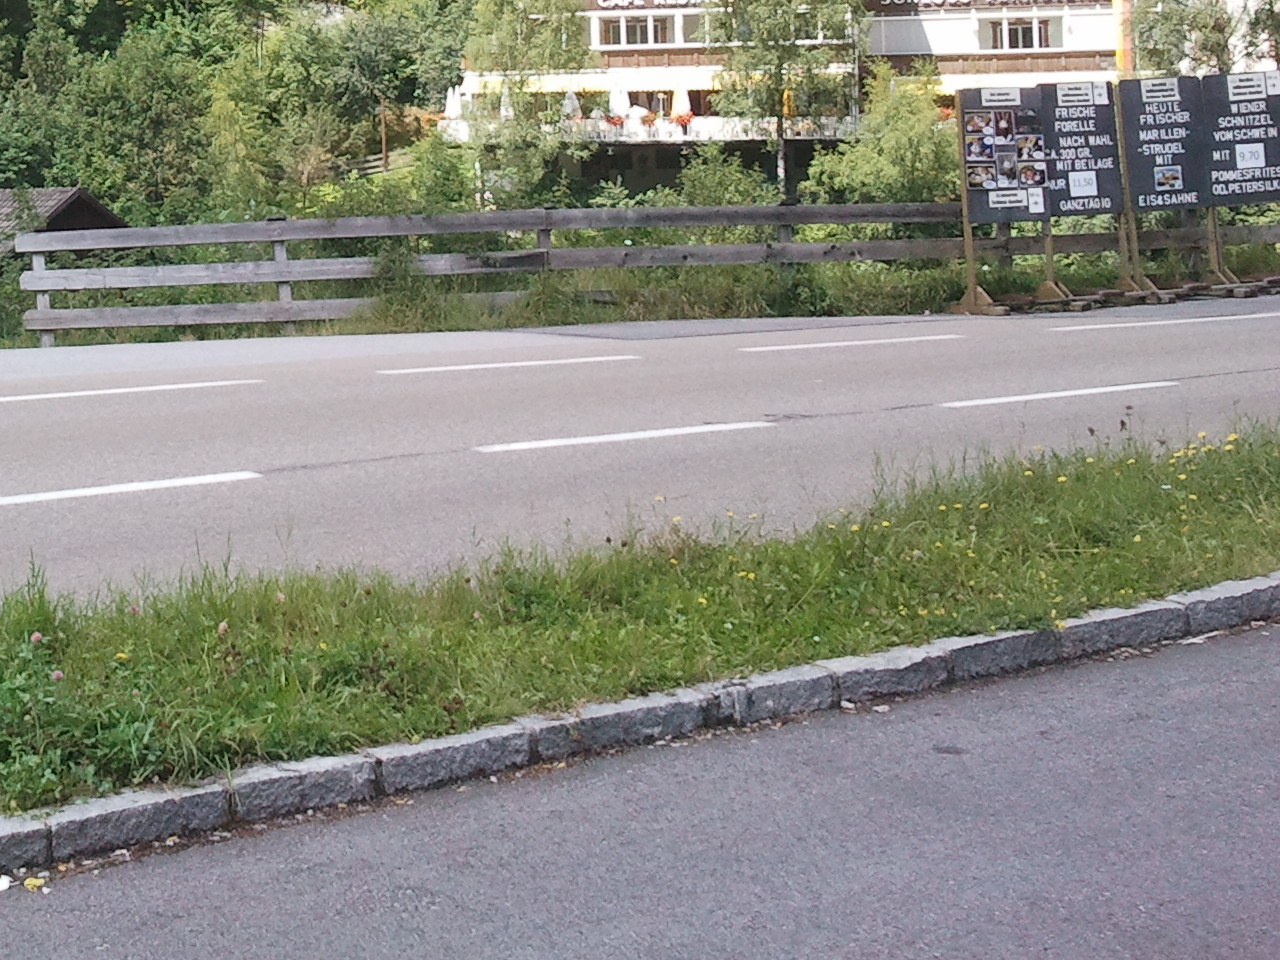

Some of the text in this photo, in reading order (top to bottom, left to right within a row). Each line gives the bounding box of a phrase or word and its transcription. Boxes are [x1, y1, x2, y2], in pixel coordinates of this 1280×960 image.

[1055, 106, 1096, 119] FRISCHE
[1145, 101, 1181, 114] HEUTE
[1230, 100, 1267, 114] WIENER
[1139, 111, 1191, 125] FRISCHER
[1217, 114, 1273, 128] SCHNITZEL
[1054, 120, 1096, 132] FORELLE
[1059, 134, 1113, 147] NACH WAHL
[1155, 154, 1173, 165] MIT
[1212, 149, 1231, 161] MIT
[1056, 157, 1114, 171] MIT BEILAGE
